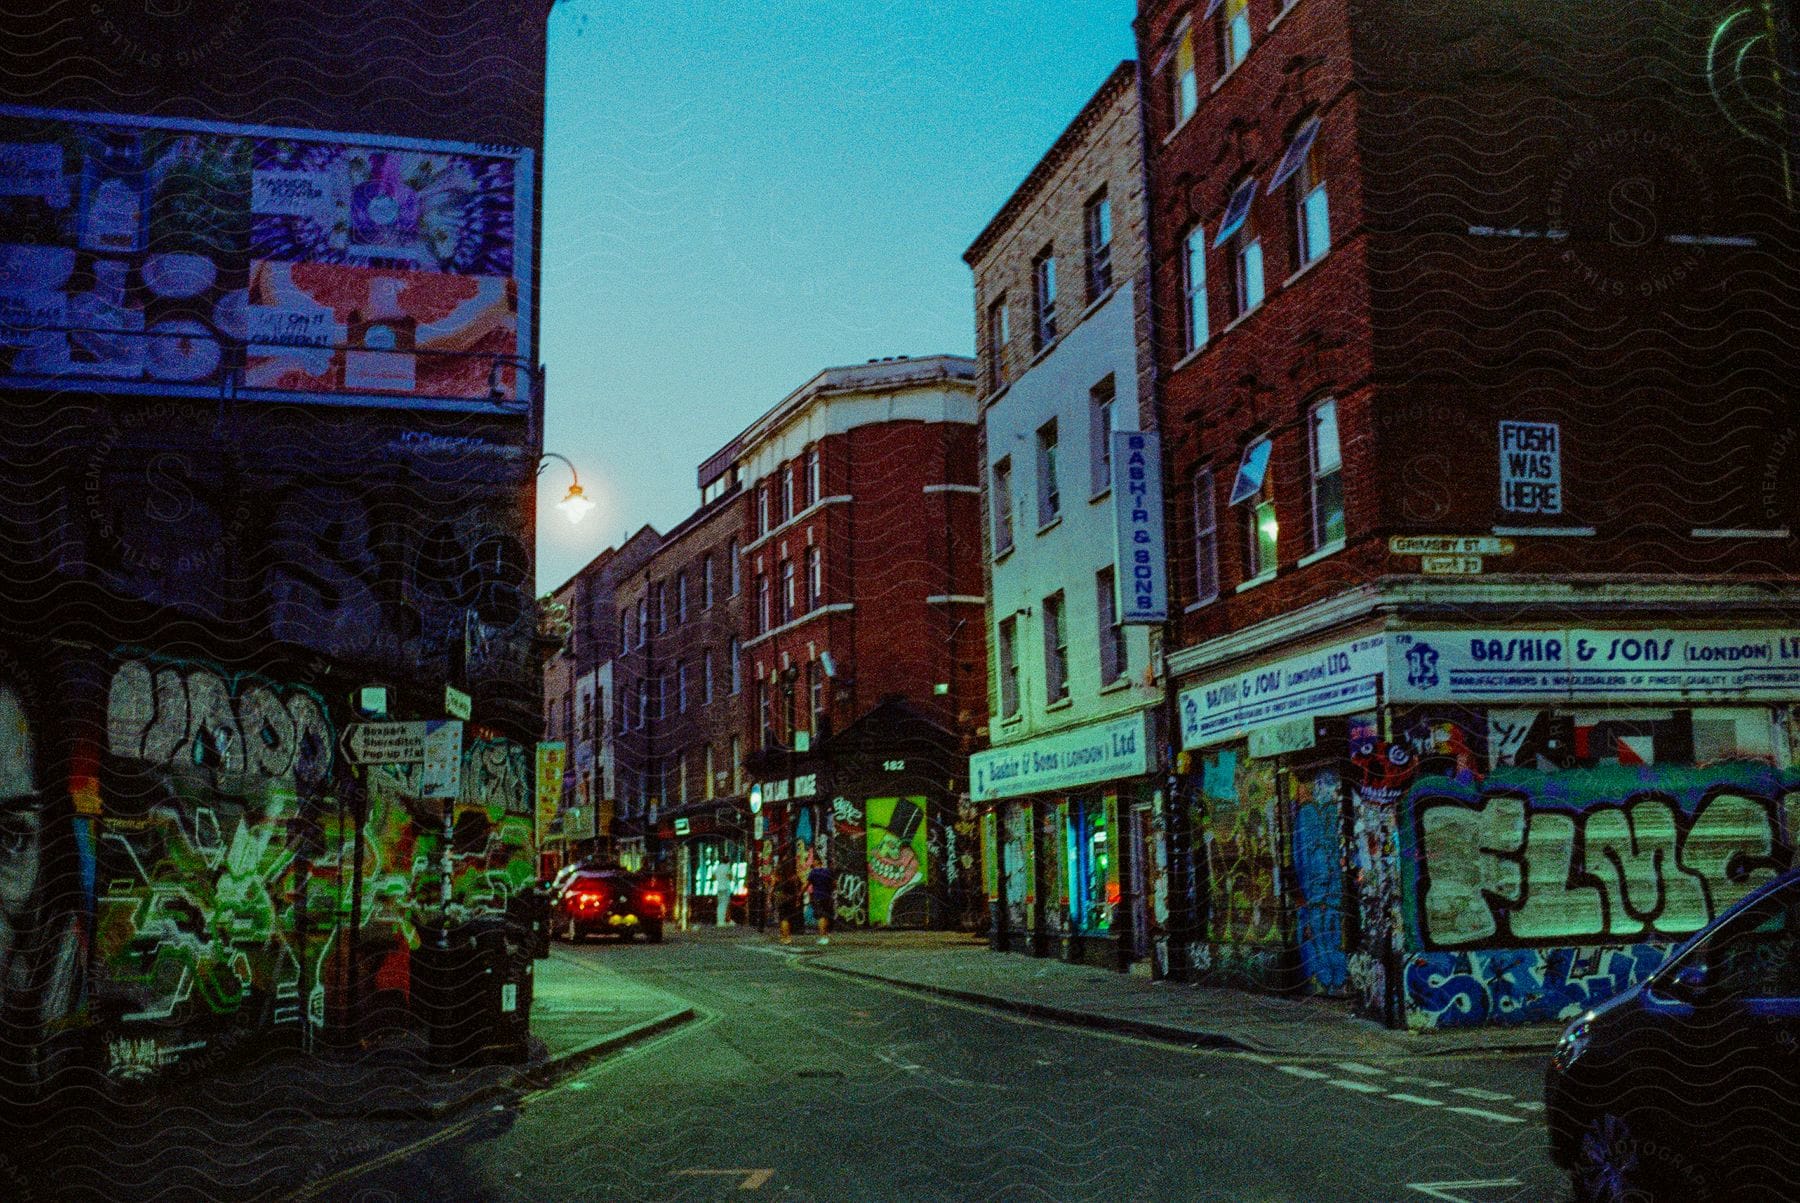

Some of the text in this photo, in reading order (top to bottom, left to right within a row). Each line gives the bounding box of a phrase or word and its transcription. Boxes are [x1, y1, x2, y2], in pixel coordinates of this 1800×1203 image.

[1508, 453, 1552, 478] WAS
[1128, 436, 1149, 523] BASHIR
[1505, 482, 1557, 509] HERE
[1133, 530, 1151, 543] &
[1134, 549, 1152, 609] SONS
[1471, 639, 1562, 661] BASHIR
[1577, 639, 1597, 661] &
[1608, 639, 1674, 661] SONS
[1684, 640, 1773, 663] (LONDON)
[1112, 729, 1137, 757] Ltd
[881, 759, 906, 772] 182
